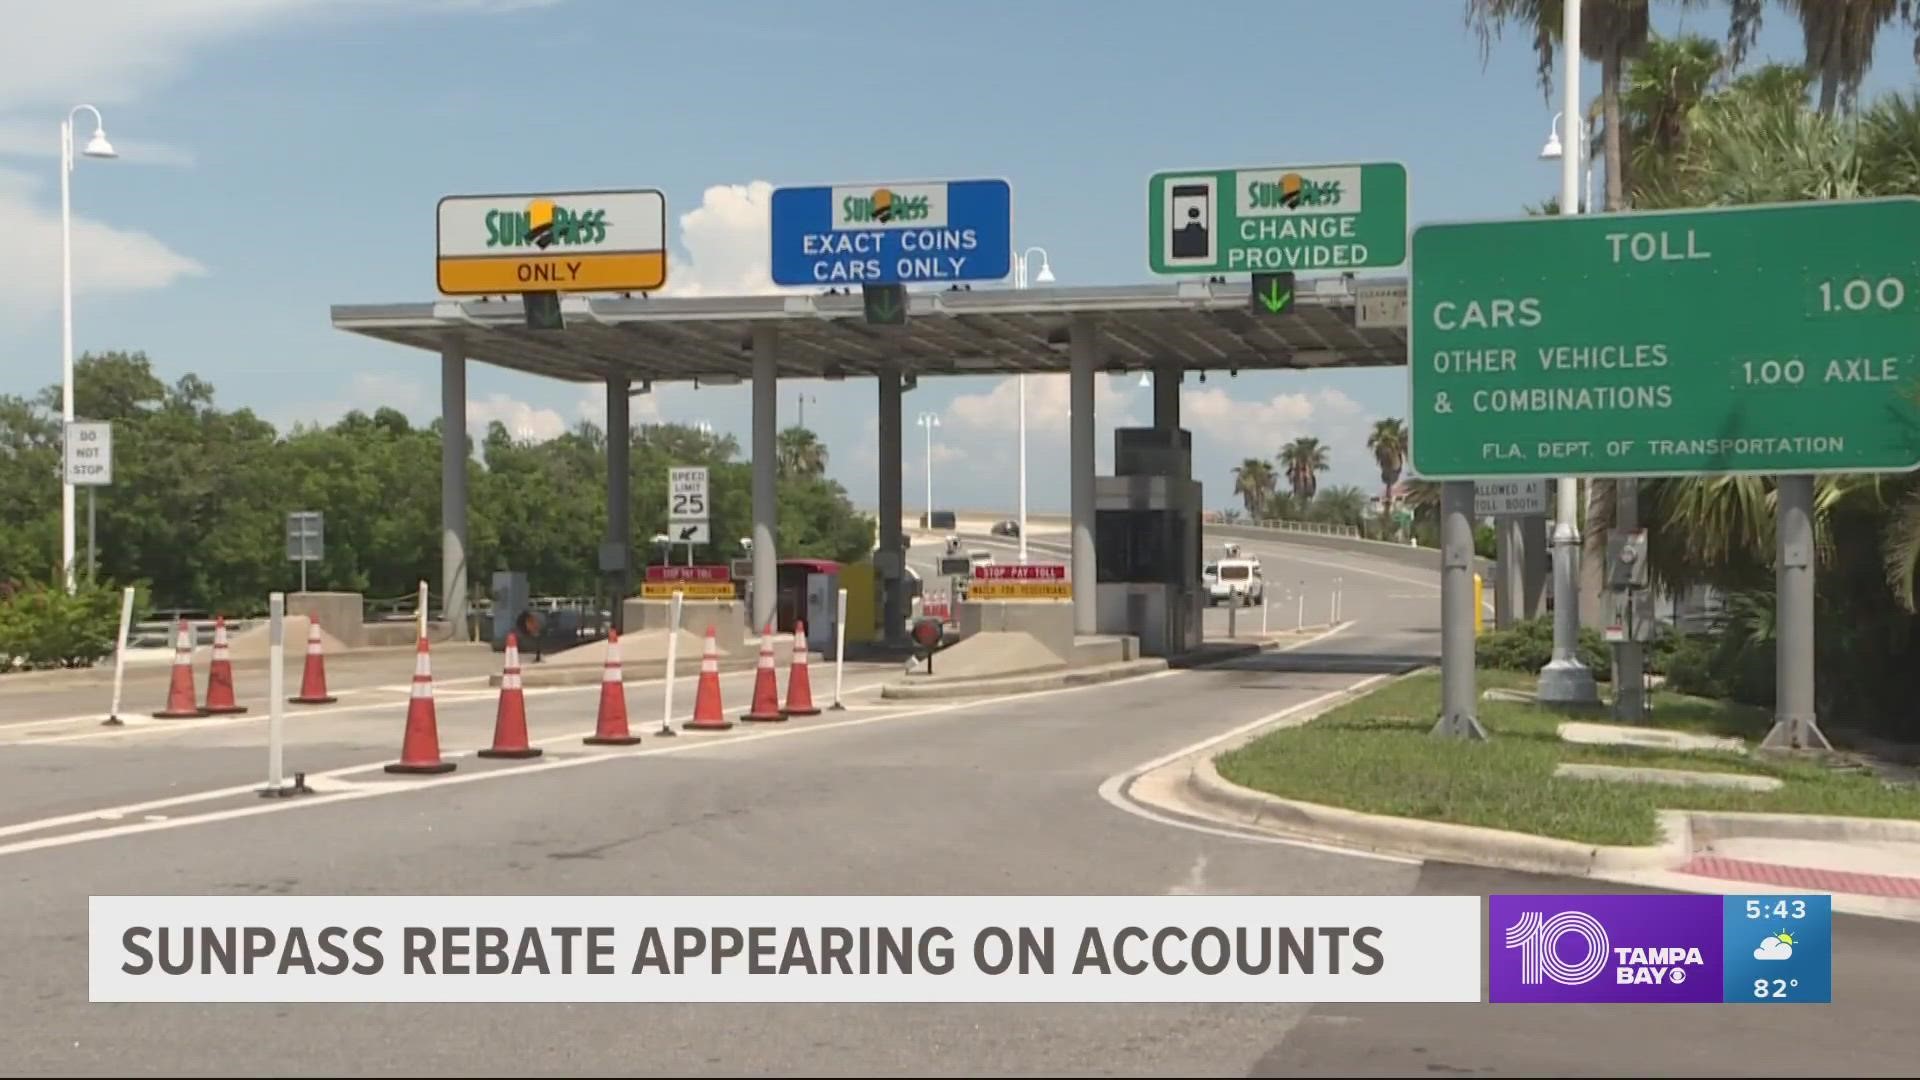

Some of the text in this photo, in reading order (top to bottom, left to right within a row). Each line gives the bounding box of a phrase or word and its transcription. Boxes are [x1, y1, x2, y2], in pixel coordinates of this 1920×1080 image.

[1240, 217, 1356, 241] CHANGE
[803, 229, 977, 255] EXACT COINS
[1605, 230, 1712, 263] TOLL
[813, 256, 966, 282] CARS ONLY
[1228, 245, 1368, 269] PROVIDED
[517, 261, 582, 283] ONLY
[1433, 298, 1542, 331] CARS
[1819, 277, 1905, 312] 1.00
[1434, 344, 1669, 374] OTHER VEHICLES
[1742, 357, 1899, 385] 1.00 AXLE
[1434, 386, 1673, 414] & COMBINATIONS
[80, 430, 97, 442] DO
[1482, 436, 1844, 460] FLA. DEPT. OF TRANSPORTATION
[76, 448, 99, 458] NOT
[73, 464, 104, 475] STOP
[672, 471, 705, 481] SPEED
[674, 483, 701, 492] LIMIT
[673, 493, 704, 515] 25
[1011, 567, 1028, 577] PAY
